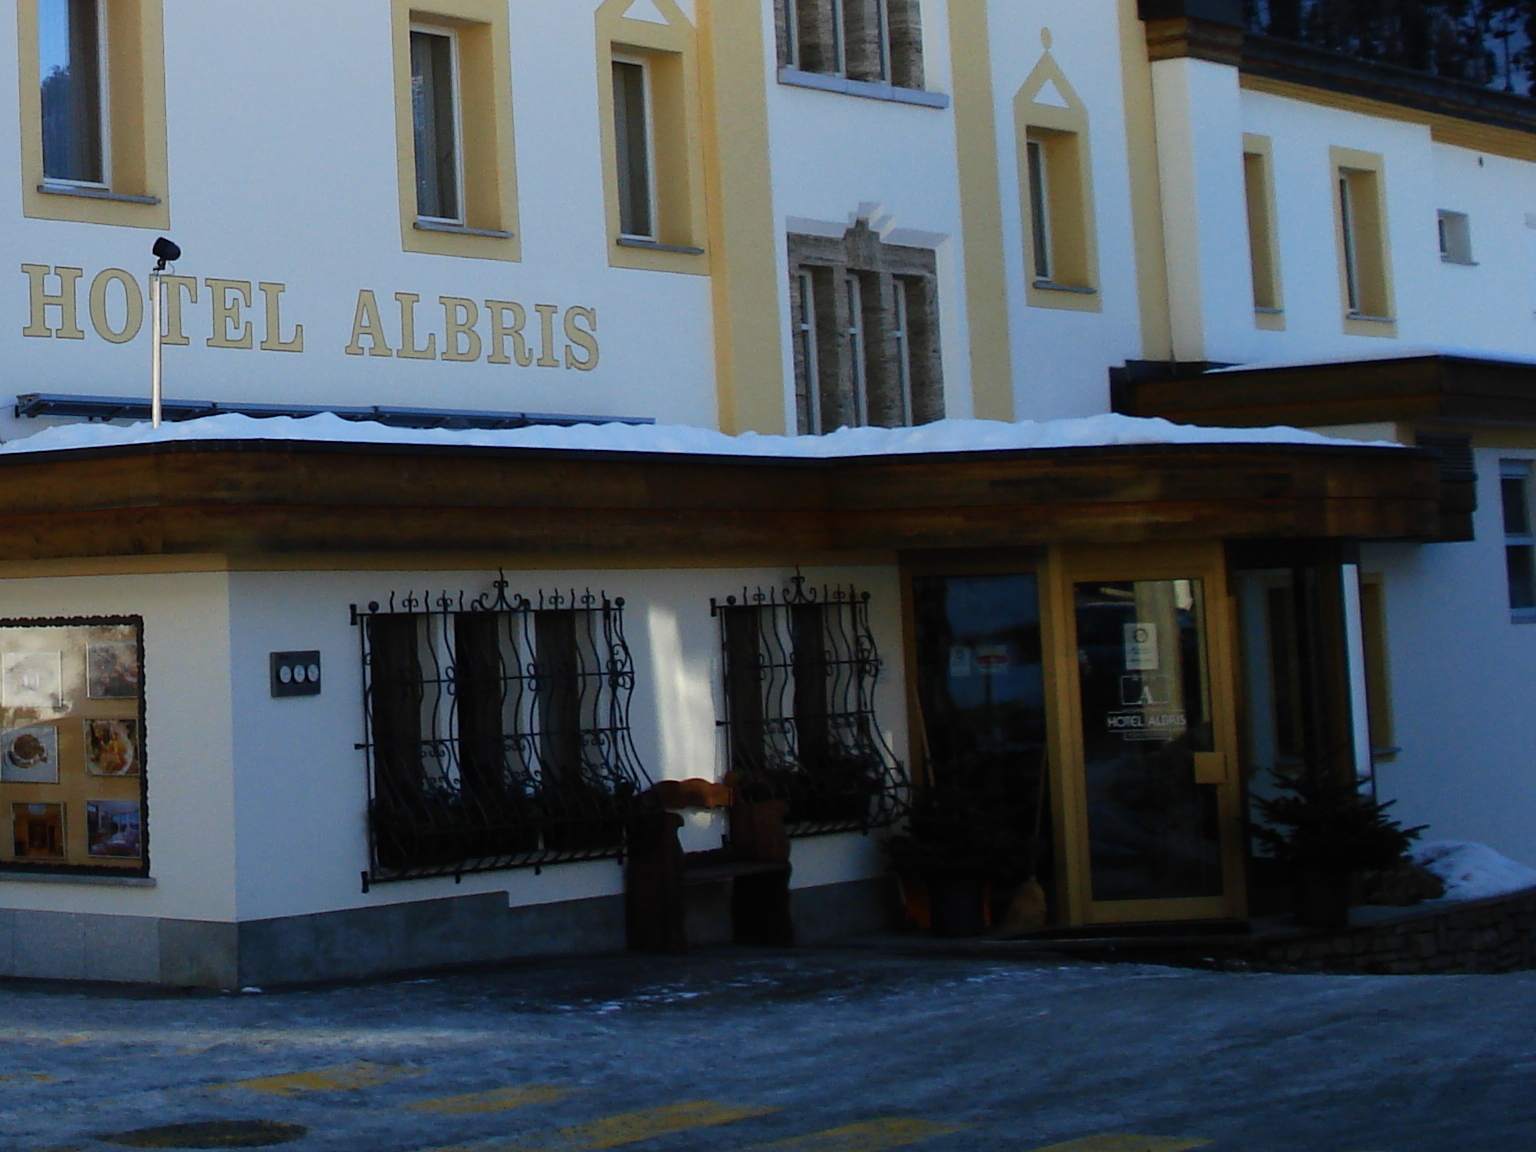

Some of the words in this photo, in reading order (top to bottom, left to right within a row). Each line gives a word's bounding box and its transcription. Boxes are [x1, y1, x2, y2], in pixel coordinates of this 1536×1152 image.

[21, 263, 304, 353] HOTEL
[345, 288, 600, 372] ALBRIS
[1107, 715, 1144, 728] HOTEL
